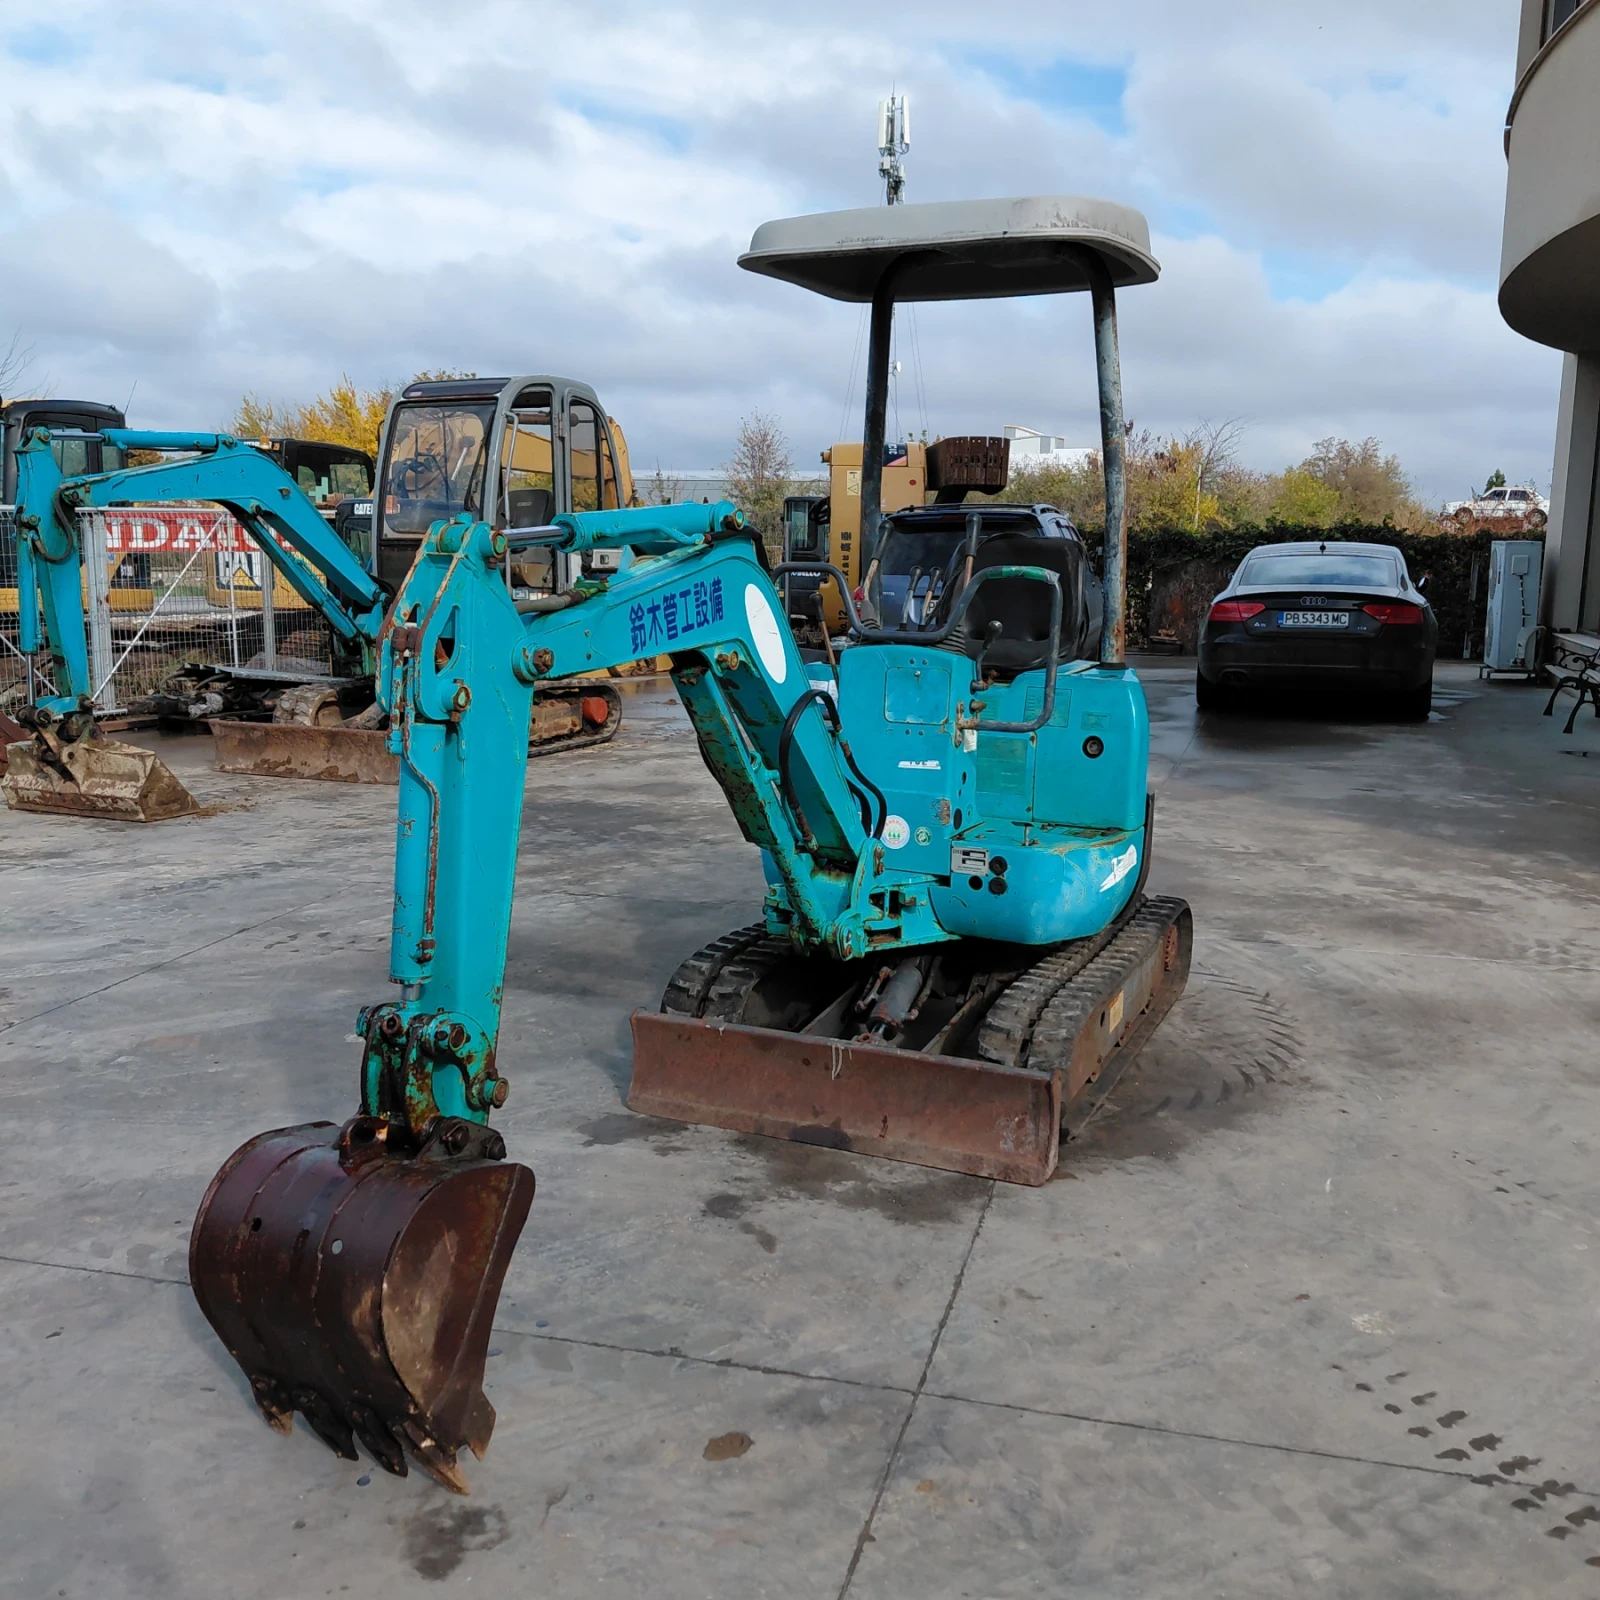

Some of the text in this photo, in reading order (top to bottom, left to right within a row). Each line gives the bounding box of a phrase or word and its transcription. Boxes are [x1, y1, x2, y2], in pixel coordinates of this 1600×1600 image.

[629, 576, 724, 655] 鈴木管工設備
